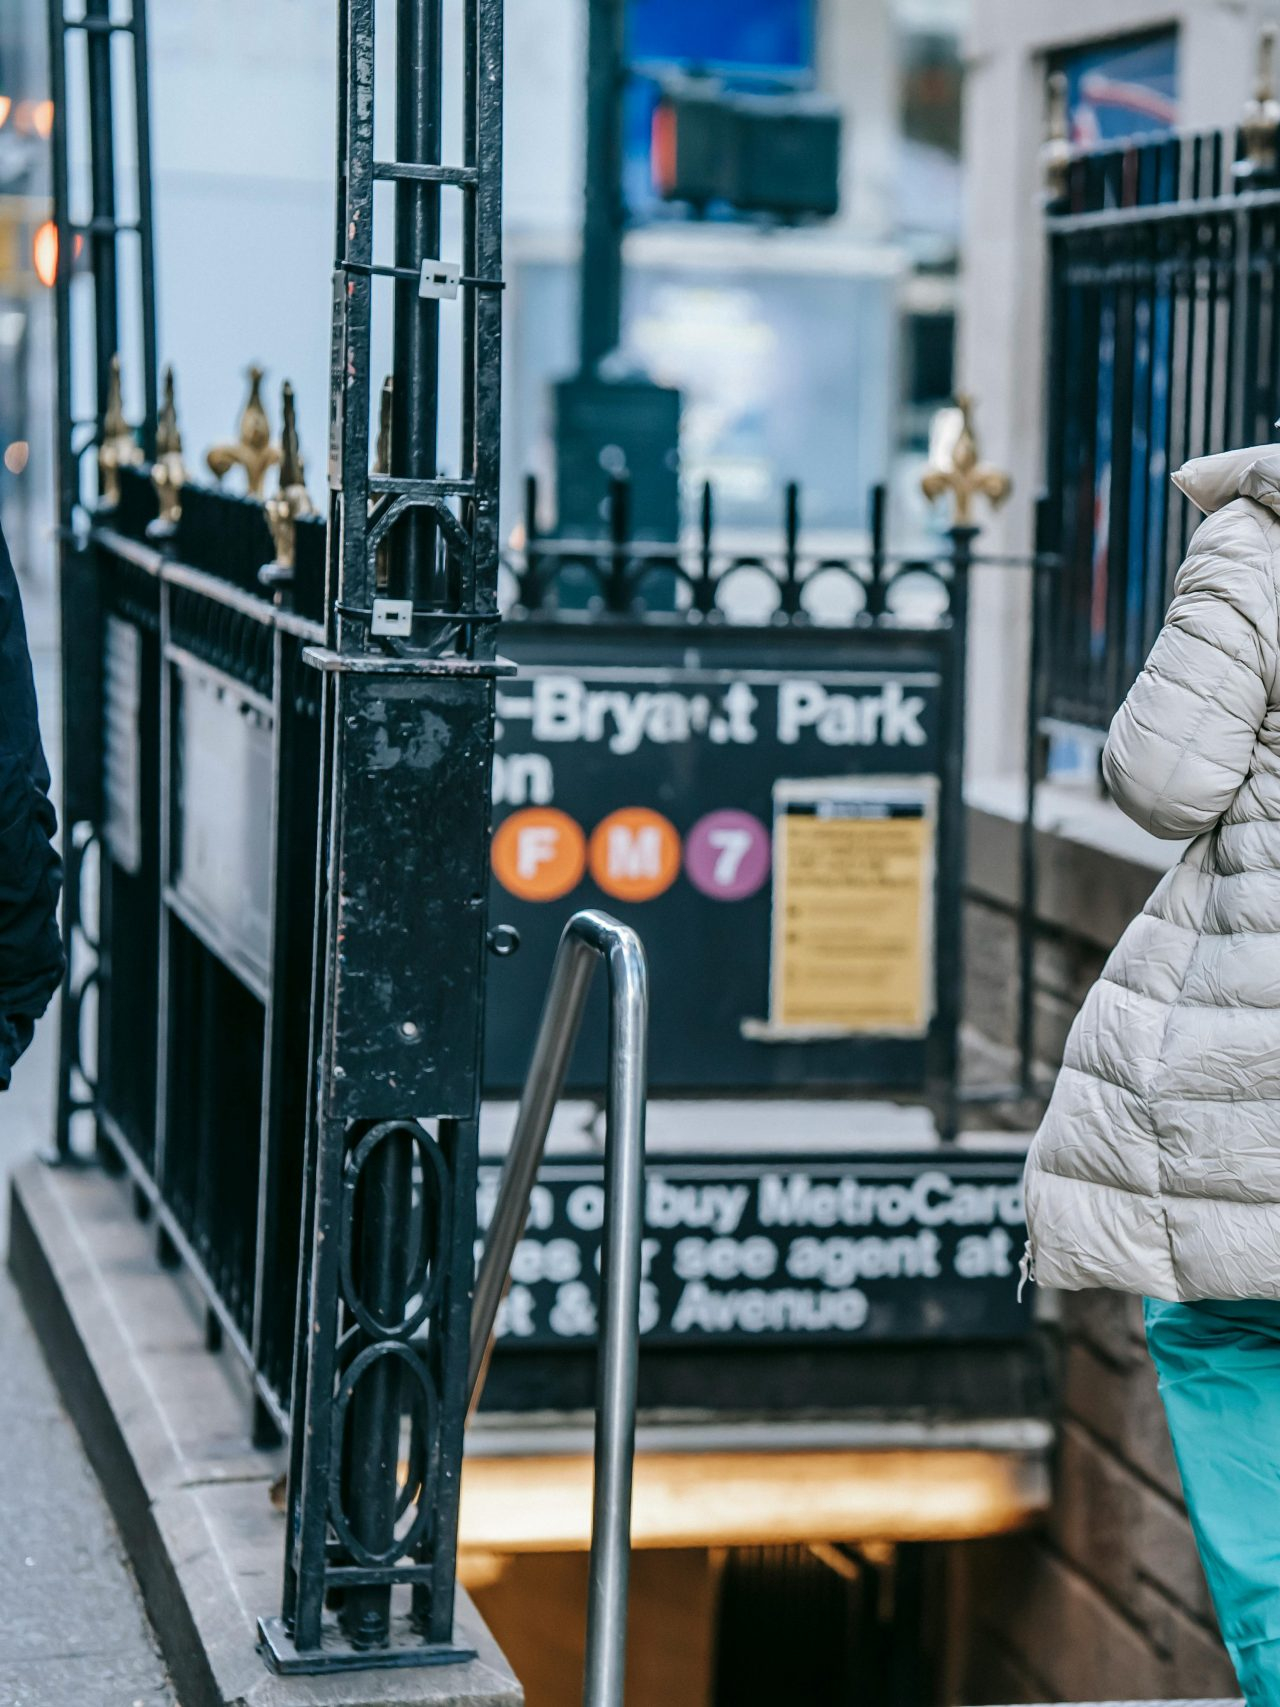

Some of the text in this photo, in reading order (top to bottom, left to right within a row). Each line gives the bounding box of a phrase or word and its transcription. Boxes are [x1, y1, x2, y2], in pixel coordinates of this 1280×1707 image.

[776, 680, 928, 746] Park
[515, 826, 560, 881] F
[605, 825, 662, 881] M
[708, 827, 753, 886] 7
[645, 1173, 750, 1235] buy
[672, 1235, 780, 1281] see
[785, 1228, 943, 1288] agent
[953, 1226, 1015, 1279] at
[670, 1278, 869, 1334] Avenue
